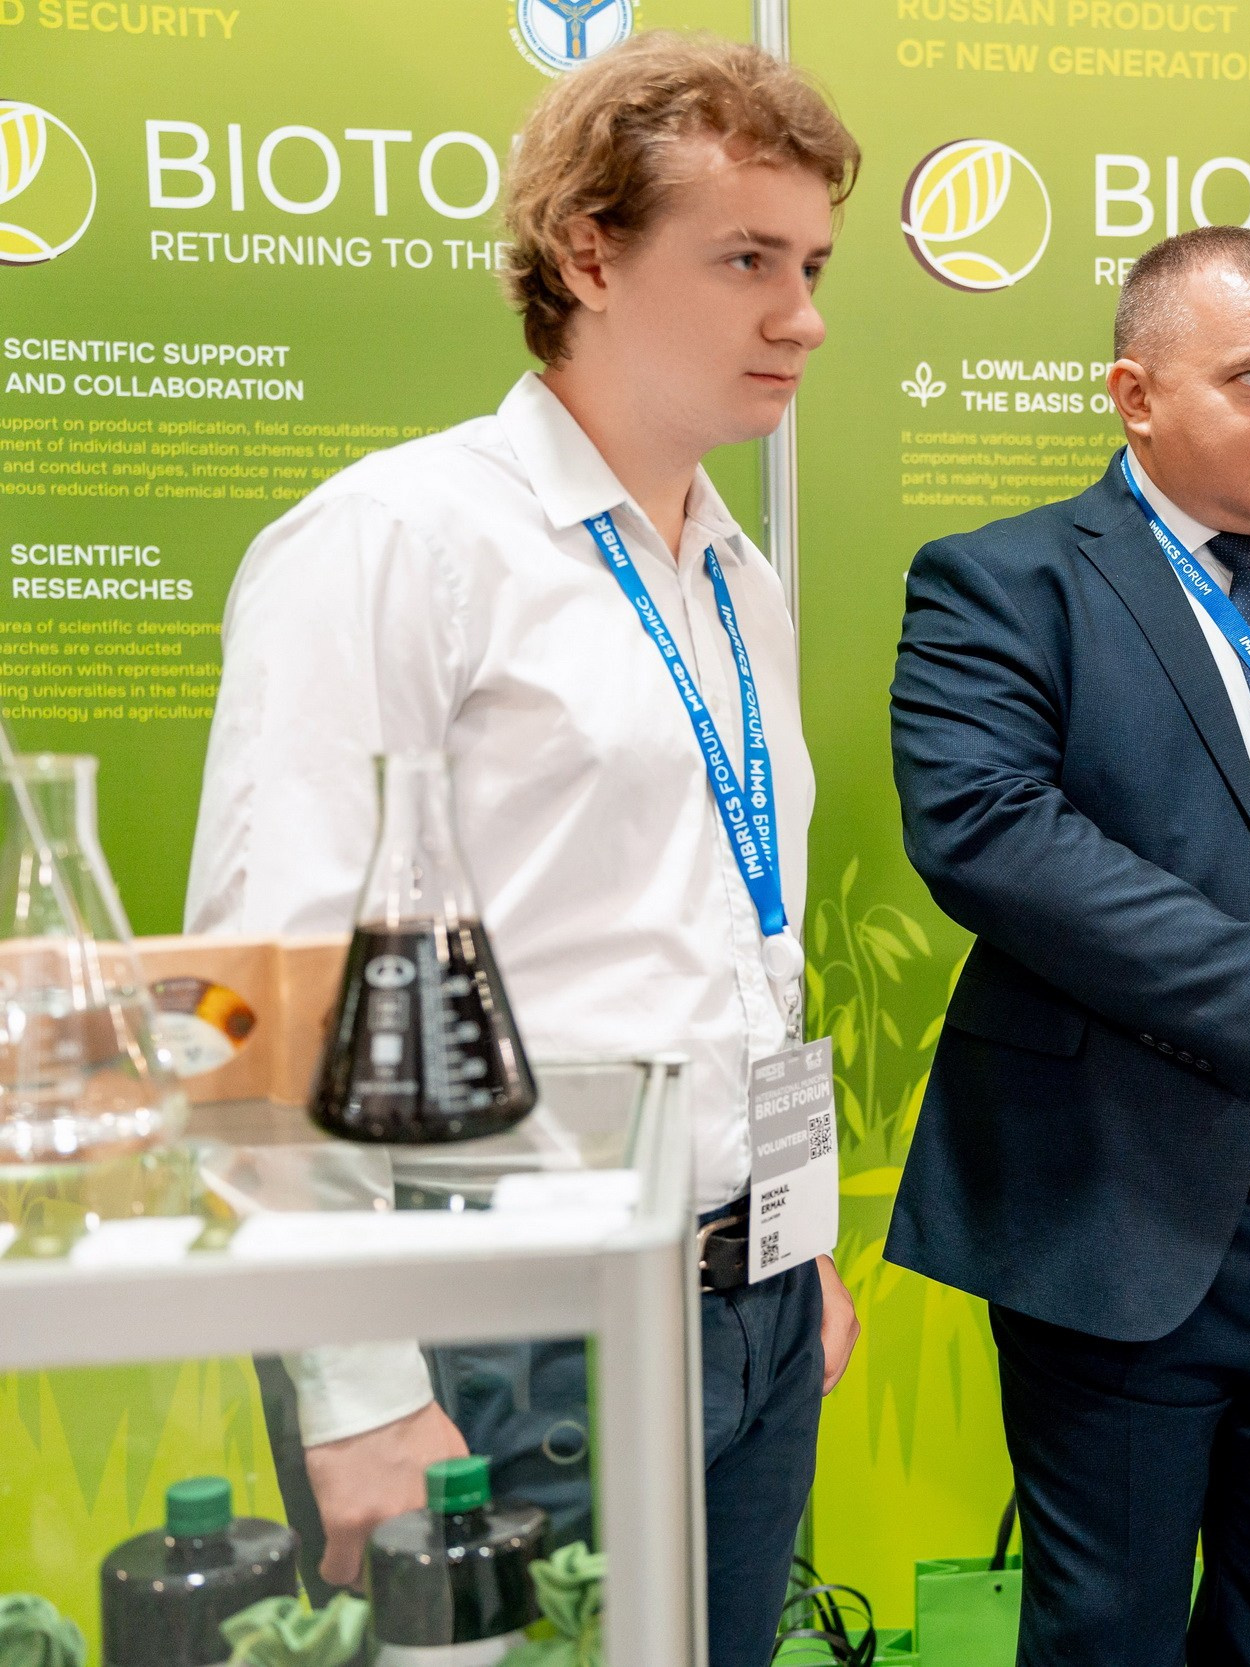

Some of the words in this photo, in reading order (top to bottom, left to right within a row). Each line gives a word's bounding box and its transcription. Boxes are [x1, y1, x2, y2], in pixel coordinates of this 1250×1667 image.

[39, 0, 240, 39] SECURITY
[897, 0, 1056, 26] RUSSIAN
[1068, 0, 1238, 34] PRODUCT
[897, 39, 946, 69] OF
[956, 42, 1038, 73] NEW
[150, 230, 372, 267] RETURNING
[381, 238, 433, 268] TO
[3, 338, 155, 363] SCIENTIFIC
[163, 343, 291, 367] SUPPORT
[961, 359, 1084, 382] LOWLAND
[5, 372, 66, 395] AND
[73, 374, 304, 401] COLLABORATION
[961, 391, 1009, 412] THE
[1015, 392, 1084, 413] BASIS
[63, 419, 84, 431] on
[89, 418, 153, 434] product
[158, 420, 250, 437] application,
[255, 420, 289, 436] field
[293, 423, 399, 438] consultations
[403, 425, 423, 438] on
[47, 437, 64, 452] of
[69, 439, 147, 454] individual
[152, 441, 239, 457] application
[244, 444, 314, 458] schemes
[318, 442, 340, 458] for
[915, 432, 977, 445] contains
[980, 434, 1032, 446] various
[1036, 435, 1085, 450] groups
[1091, 432, 1105, 447] of
[3, 459, 35, 473] and
[39, 461, 107, 475] conduct
[112, 463, 188, 479] analyses,
[192, 464, 269, 478] introduce
[273, 466, 308, 479] new
[1040, 453, 1068, 467] and
[51, 482, 129, 497] reduction
[134, 483, 150, 497] of
[155, 484, 225, 499] chemical
[230, 486, 269, 500] load,
[901, 472, 932, 487] part
[936, 473, 948, 486] is
[951, 474, 998, 489] mainly
[1001, 475, 1086, 490] represented
[901, 493, 985, 507] substances,
[991, 493, 1030, 507] micro
[11, 544, 161, 567] SCIENTIFIC
[1148, 519, 1181, 561] IMBRICS
[1176, 556, 1213, 597] FORUM
[12, 577, 193, 600] RESEARCHES
[37, 619, 54, 635] of
[59, 619, 132, 635] scientific
[635, 594, 677, 658] БРИКС
[64, 643, 89, 656] are
[95, 641, 182, 656] conducted
[78, 662, 113, 677] with
[720, 604, 751, 683] IMBRICS
[744, 681, 766, 749] FORUM
[33, 683, 126, 698] universities
[131, 685, 145, 698] in
[150, 684, 176, 699] the
[673, 661, 704, 712] ММФ
[93, 705, 124, 719] and
[698, 719, 736, 794] FORUM
[749, 758, 768, 810] ММФ
[718, 794, 764, 880] IMBRICS
[755, 1094, 792, 1121] BRICS
[791, 1080, 831, 1113] FORUM
[756, 1129, 808, 1157] VOLUNTEER
[761, 1184, 790, 1203] MIKHAIL
[761, 1197, 787, 1216] ERMAK
